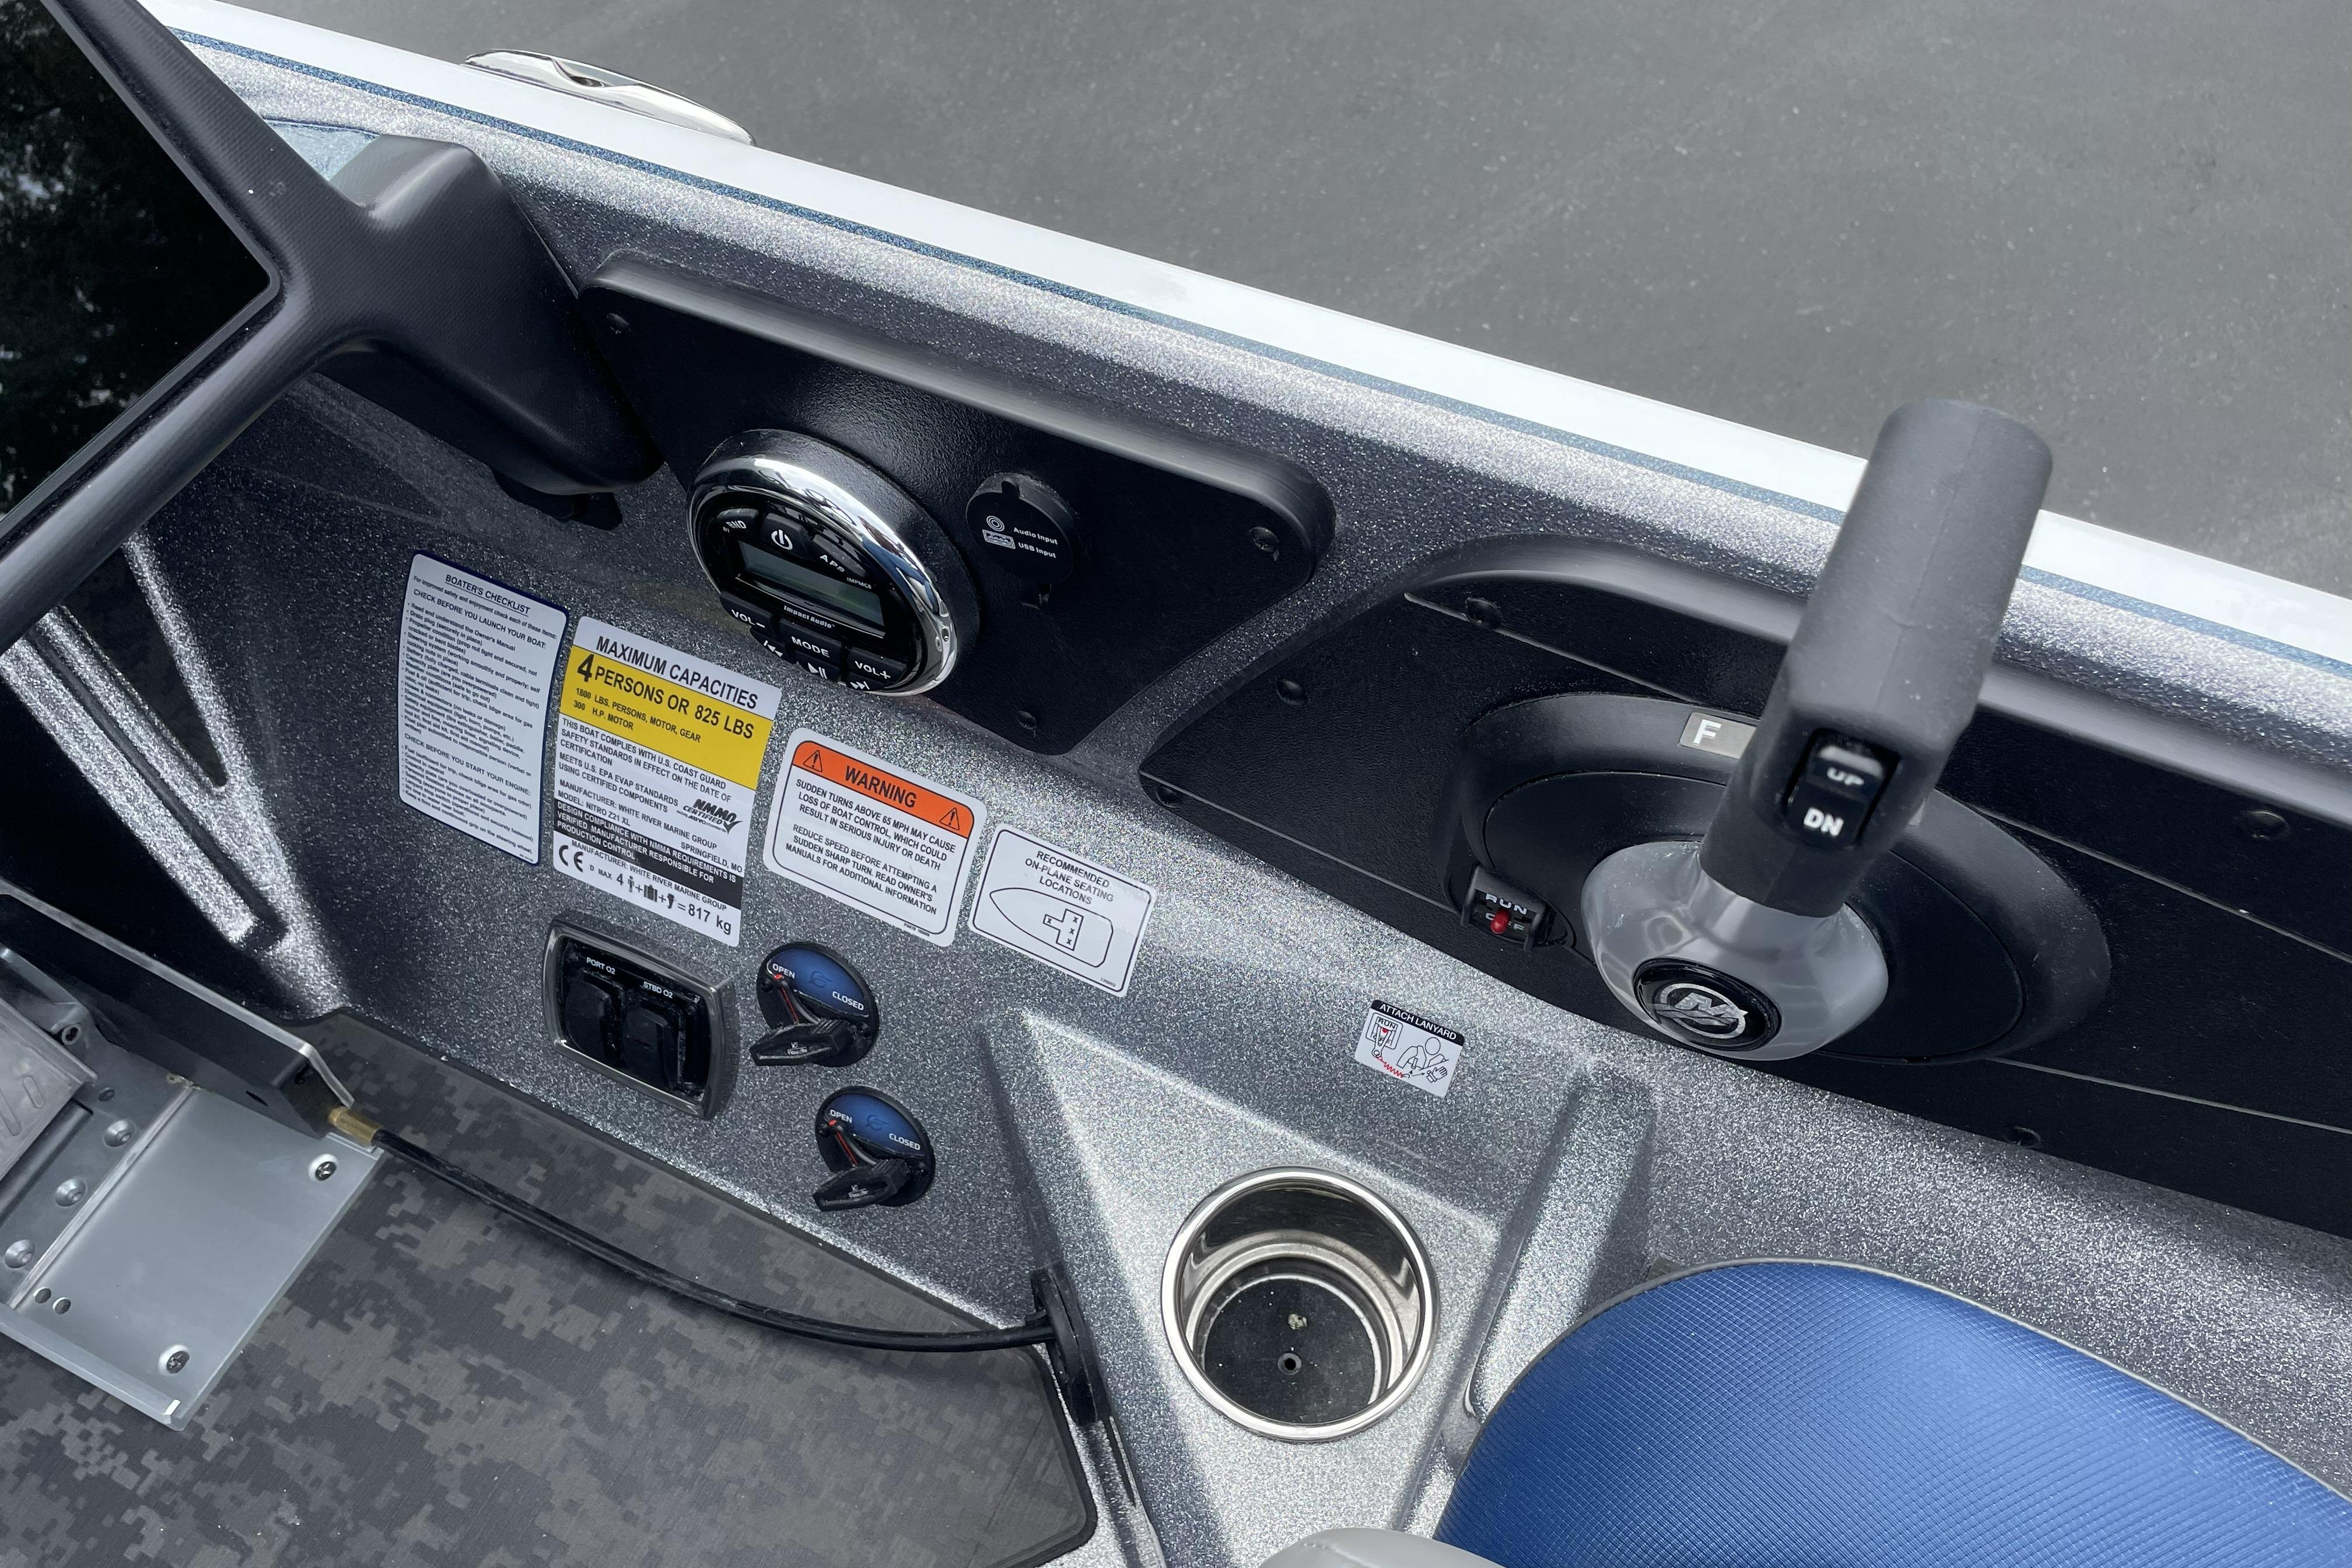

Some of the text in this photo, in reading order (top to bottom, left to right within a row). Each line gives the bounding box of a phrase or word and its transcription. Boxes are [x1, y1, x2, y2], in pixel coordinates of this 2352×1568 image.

[1014, 527, 1058, 545] Audio Input
[1019, 542, 1056, 558] USB Input
[820, 555, 845, 572] APS
[444, 574, 530, 613] BOATER'S CHECKLIST
[413, 589, 436, 603] CHECK
[436, 598, 463, 614] BEFORE
[464, 609, 478, 620] YOU
[478, 615, 506, 632] LAUNCH
[508, 627, 526, 640] YOUR
[784, 605, 832, 628] Impact Audio
[791, 636, 830, 658] MODE
[596, 635, 758, 709] MAXIMUM CAPACITIES
[573, 699, 585, 710] 300
[607, 713, 634, 730] MOTOR
[577, 654, 754, 738] 4 PERSONS OR 825 LBS
[576, 687, 591, 699] 1800
[611, 701, 648, 723] PERSONS,
[649, 716, 677, 734] MOTOR,
[680, 728, 701, 743] GEAR
[1692, 719, 1722, 746] F
[404, 733, 424, 747] CHECK
[425, 743, 450, 759] BEFORE
[451, 755, 464, 765] YOU
[465, 761, 485, 775] START
[486, 771, 503, 783] YOUR
[560, 738, 612, 765] CERTIFICATION
[561, 728, 732, 802] SAFETY STANDARDS IN EFFECT ON THE DATE OF
[562, 717, 578, 730] THIS
[579, 724, 599, 738] BOAT
[600, 733, 636, 754] COMPLIES
[638, 747, 656, 761] WITH
[673, 762, 698, 778] COAST
[699, 773, 726, 789] GUARD
[559, 751, 582, 767] MEETS
[598, 768, 612, 780] EPA
[614, 774, 634, 787] EVAP
[635, 783, 678, 806] STANDARDS
[559, 761, 667, 813] USING CERTIFIED COMPONENTS
[845, 765, 916, 807] WARNING
[1826, 767, 1865, 788] UP
[558, 789, 630, 826] MODEL: NITRO Z21 XL
[559, 779, 717, 849] MANUFACTURER: WHITE RIVER MARINE GROUP
[683, 806, 723, 824] CERTIFIED
[796, 779, 956, 853] SUDDEN TURNS ABOVE 65 MPH MAY CAUSE
[798, 791, 947, 860] LOSS OF BOAT CONTROL, WHICH COULD
[1803, 807, 1846, 837] DN
[556, 820, 635, 860] PRODUCTION CONTROL
[557, 801, 737, 883] DESIGN COMPLIANCE WITH NMMA REQUIREMENTS IS
[590, 825, 648, 855] MANUFACTURER
[649, 849, 698, 876] RESPONSIBLE
[699, 870, 713, 883] FOR
[799, 803, 940, 870] RESULT IN SERIOUS INJURY OR DEATH
[572, 839, 727, 911] MANUFACTURER: WHITE RIVER MARINE GROUP
[681, 841, 742, 873] SPRINGFIELD, MO
[793, 824, 936, 892] REDUCE SPEED BEFORE ATTEMPTING A
[793, 835, 824, 854] SUDDEN
[824, 849, 850, 864] SHARP
[875, 870, 896, 886] READ
[897, 881, 932, 901] OWNER'S
[1036, 850, 1109, 887] RECOMMENDED
[598, 868, 612, 880] MAX
[616, 873, 624, 886] 4
[785, 842, 937, 915] MANUALS FOR ADDITIONAL INFORMATION
[1025, 858, 1113, 901] ON-PLANE SEATING
[1039, 876, 1091, 904] LOCATIONS
[688, 904, 732, 935] 817 kg
[1485, 893, 1527, 915] RUN
[586, 957, 605, 970] PORT
[772, 963, 795, 979] OPEN
[643, 981, 662, 993] STBD
[832, 991, 864, 1010] CLOSED
[1377, 1019, 1396, 1029] RUN
[1379, 1003, 1456, 1040] ATTACH LANYARD
[830, 1110, 852, 1123] OPEN
[889, 1133, 921, 1150] CLOSED
